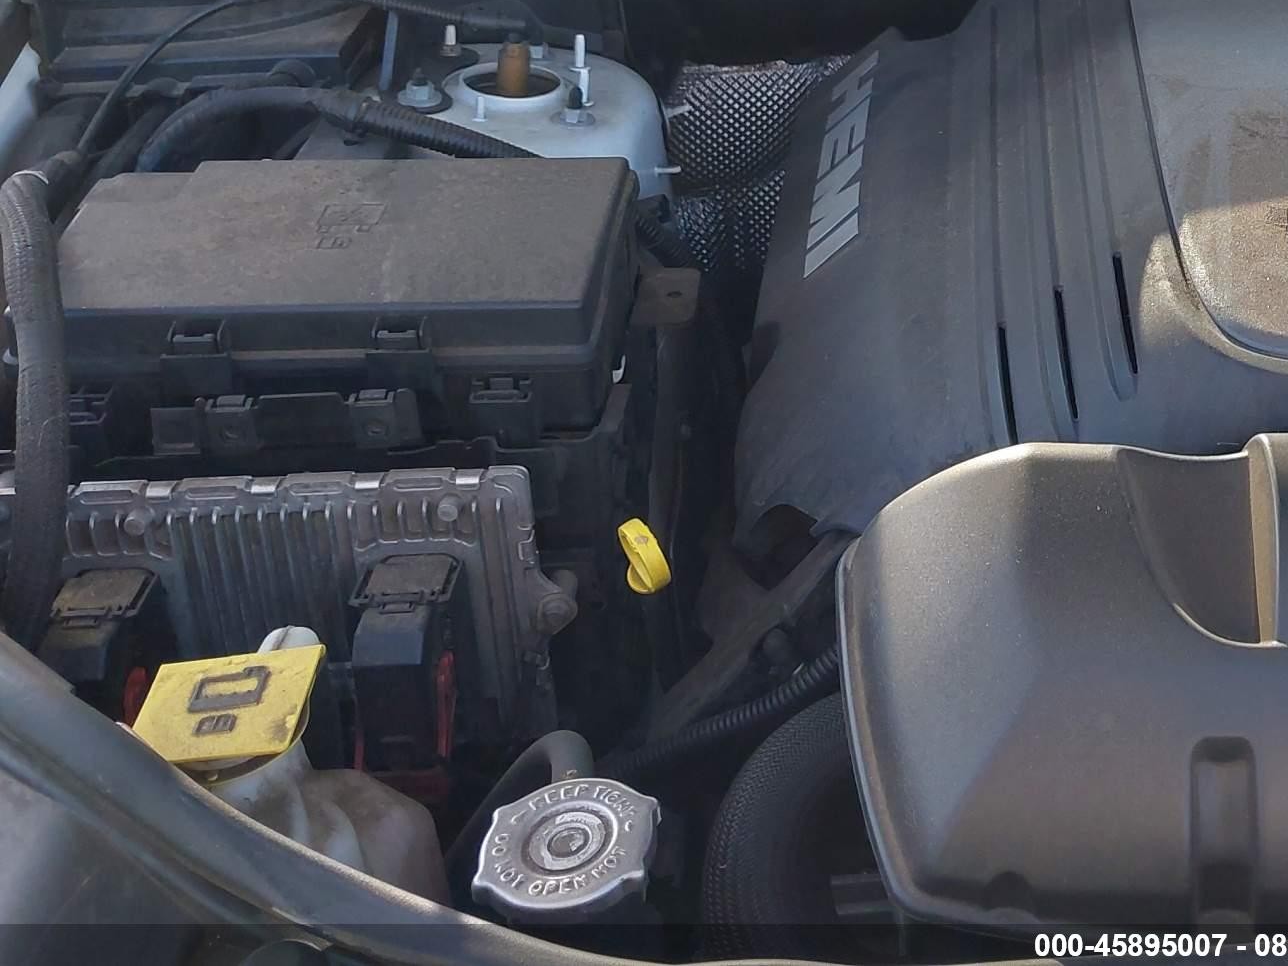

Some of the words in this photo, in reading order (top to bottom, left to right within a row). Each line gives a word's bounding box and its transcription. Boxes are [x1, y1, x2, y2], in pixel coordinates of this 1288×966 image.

[803, 49, 879, 279] HEMI
[528, 783, 588, 812] KEEP
[491, 833, 510, 857] DO
[494, 860, 524, 888] NOT
[590, 844, 627, 880] HOT
[528, 873, 587, 897] OPEN
